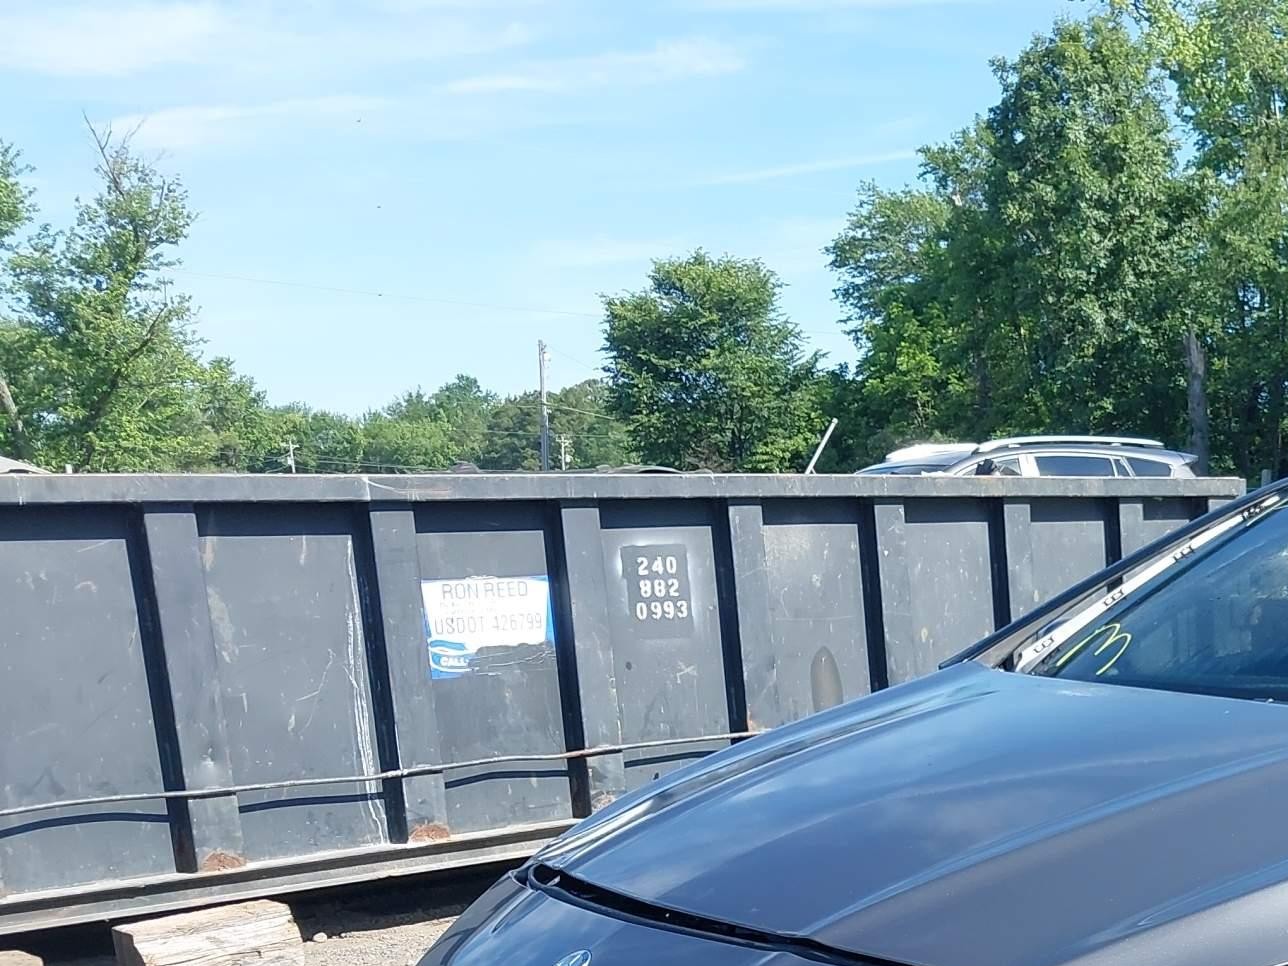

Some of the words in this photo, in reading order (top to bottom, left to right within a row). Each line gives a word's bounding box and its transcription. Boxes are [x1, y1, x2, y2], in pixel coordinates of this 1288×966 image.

[636, 556, 678, 576] 240
[441, 583, 479, 600] RON
[483, 581, 529, 598] REED
[639, 578, 681, 598] 882
[635, 600, 689, 620] 0993
[434, 616, 485, 635] USDOT
[492, 612, 543, 632] 426799
